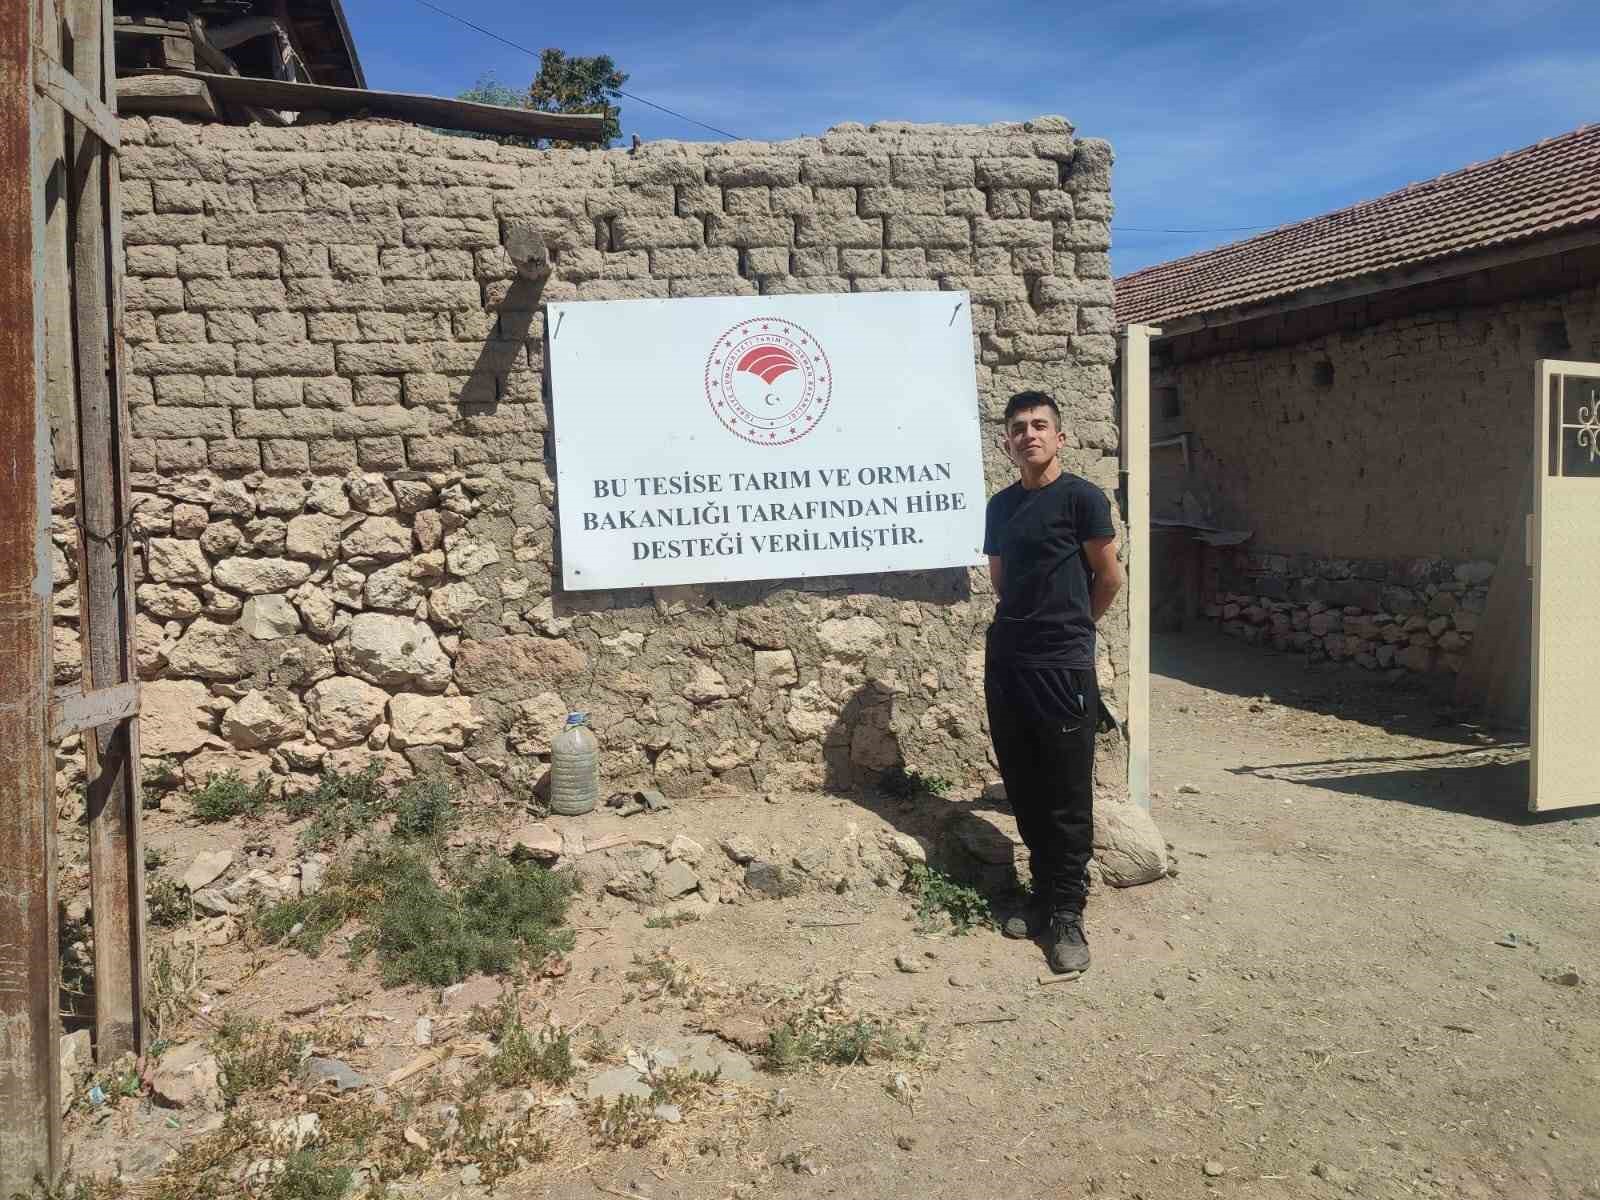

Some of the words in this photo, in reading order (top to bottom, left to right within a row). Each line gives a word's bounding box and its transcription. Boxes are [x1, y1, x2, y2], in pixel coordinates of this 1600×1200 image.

[594, 478, 627, 498] BU
[634, 471, 724, 498] TESİSE
[729, 469, 812, 493] TARIM
[816, 468, 851, 488] VE
[857, 462, 952, 487] ORMAN
[584, 501, 729, 532] BAKANLIĞI
[736, 496, 898, 526] TARAFINDAN
[906, 490, 967, 515] HİBE
[632, 531, 744, 562] DESTEĞİ
[750, 524, 925, 555] VERİLMİŞTİR.
